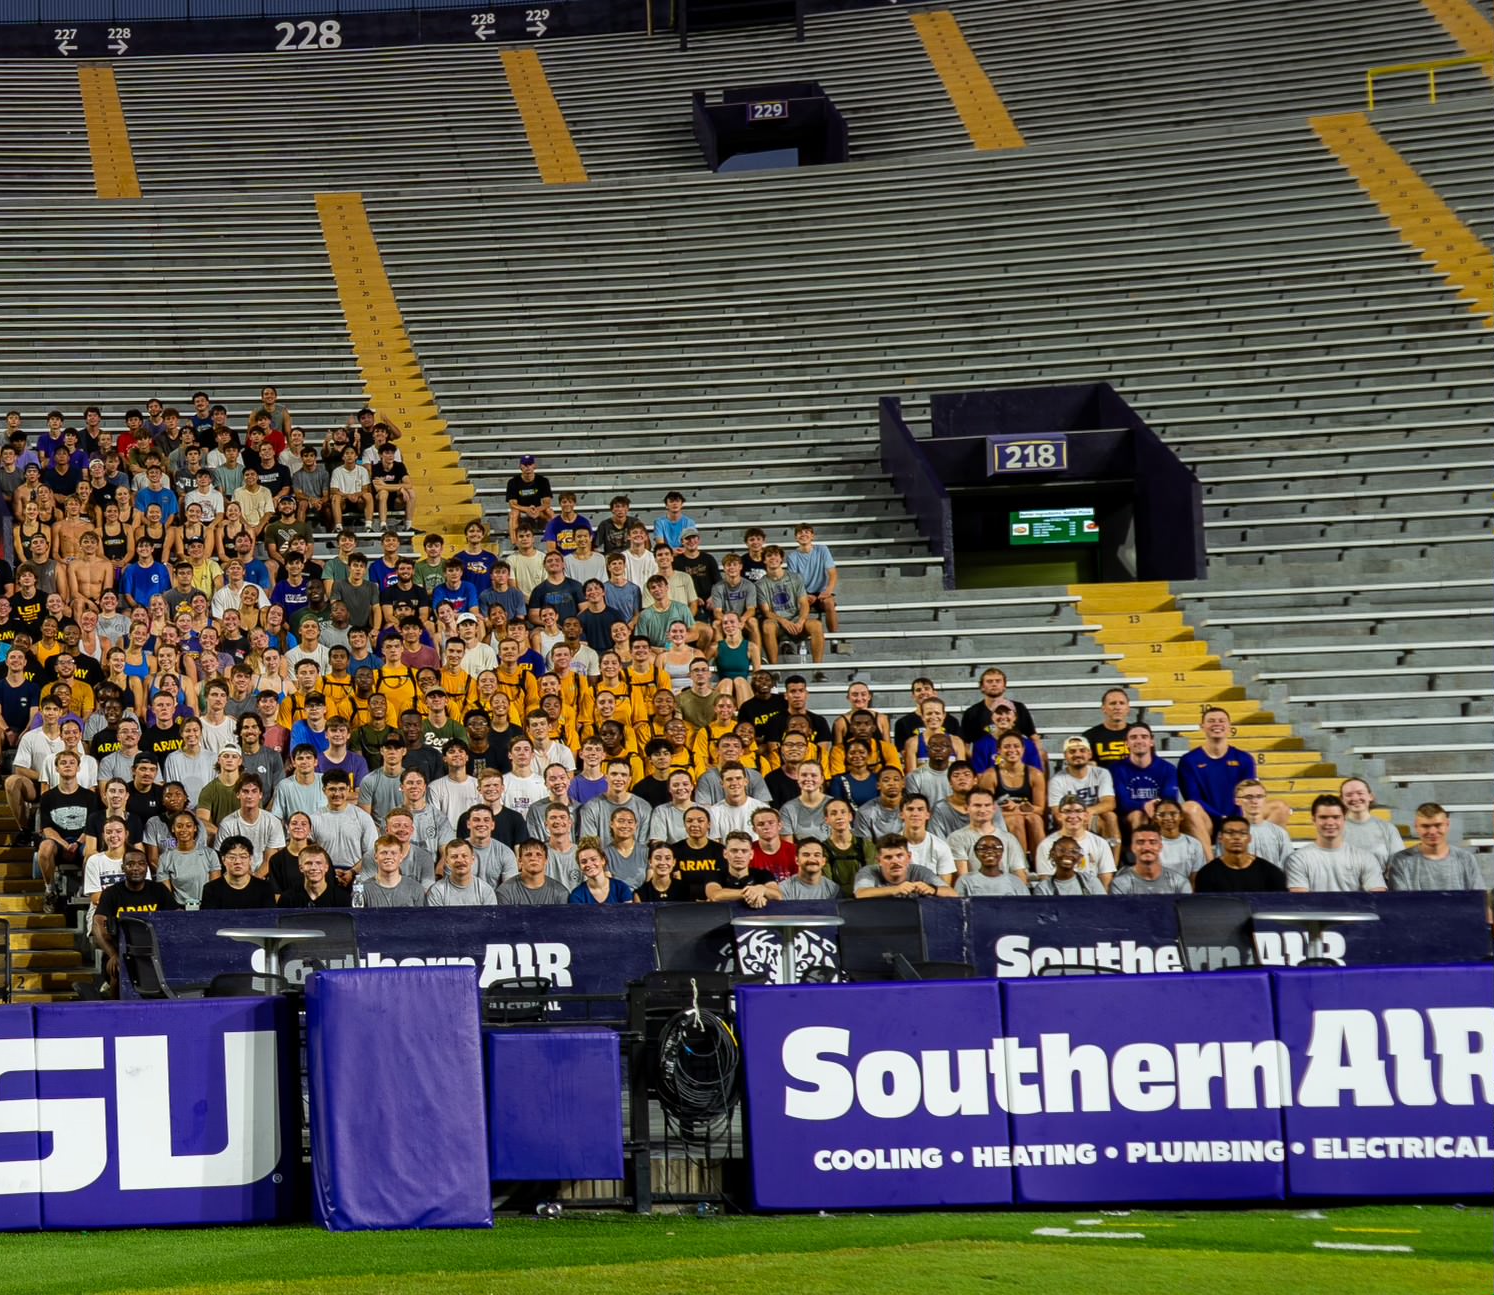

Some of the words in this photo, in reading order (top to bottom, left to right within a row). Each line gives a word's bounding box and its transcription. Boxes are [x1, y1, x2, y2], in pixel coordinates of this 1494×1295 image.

[471, 13, 495, 25] 228
[525, 9, 550, 22] 229
[54, 29, 77, 40] 227
[108, 28, 131, 39] 228
[275, 20, 342, 50] 228
[754, 104, 782, 118] 229
[1005, 444, 1056, 468] 218
[428, 486, 433, 494] 6
[18, 603, 40, 616] LSU
[1127, 614, 1140, 624] 13
[1150, 643, 1162, 653] 12
[519, 663, 533, 671] SU
[24, 672, 34, 682] MY
[73, 669, 88, 679] MY
[1173, 672, 1185, 682] 11
[754, 710, 779, 725] AR
[1230, 727, 1238, 737] 9
[98, 743, 122, 753] ARM
[153, 739, 184, 752] ARMY
[1257, 753, 1266, 764] 8
[1072, 785, 1099, 798] SU
[1288, 781, 1295, 791] 7
[160, 838, 177, 848] TIG
[679, 859, 717, 872] ARMY
[996, 935, 1242, 978] Southern
[1250, 931, 1347, 968] AIR
[478, 943, 573, 988] AIR
[16, 975, 26, 989] 2
[781, 1024, 1293, 1120] Southern
[1299, 1006, 1494, 1107] AIR
[814, 1146, 943, 1172] COOLING
[972, 1143, 1097, 1168] HEATING
[1127, 1139, 1284, 1165] PLUMBING
[1313, 1134, 1494, 1161] ELECTRICAL
